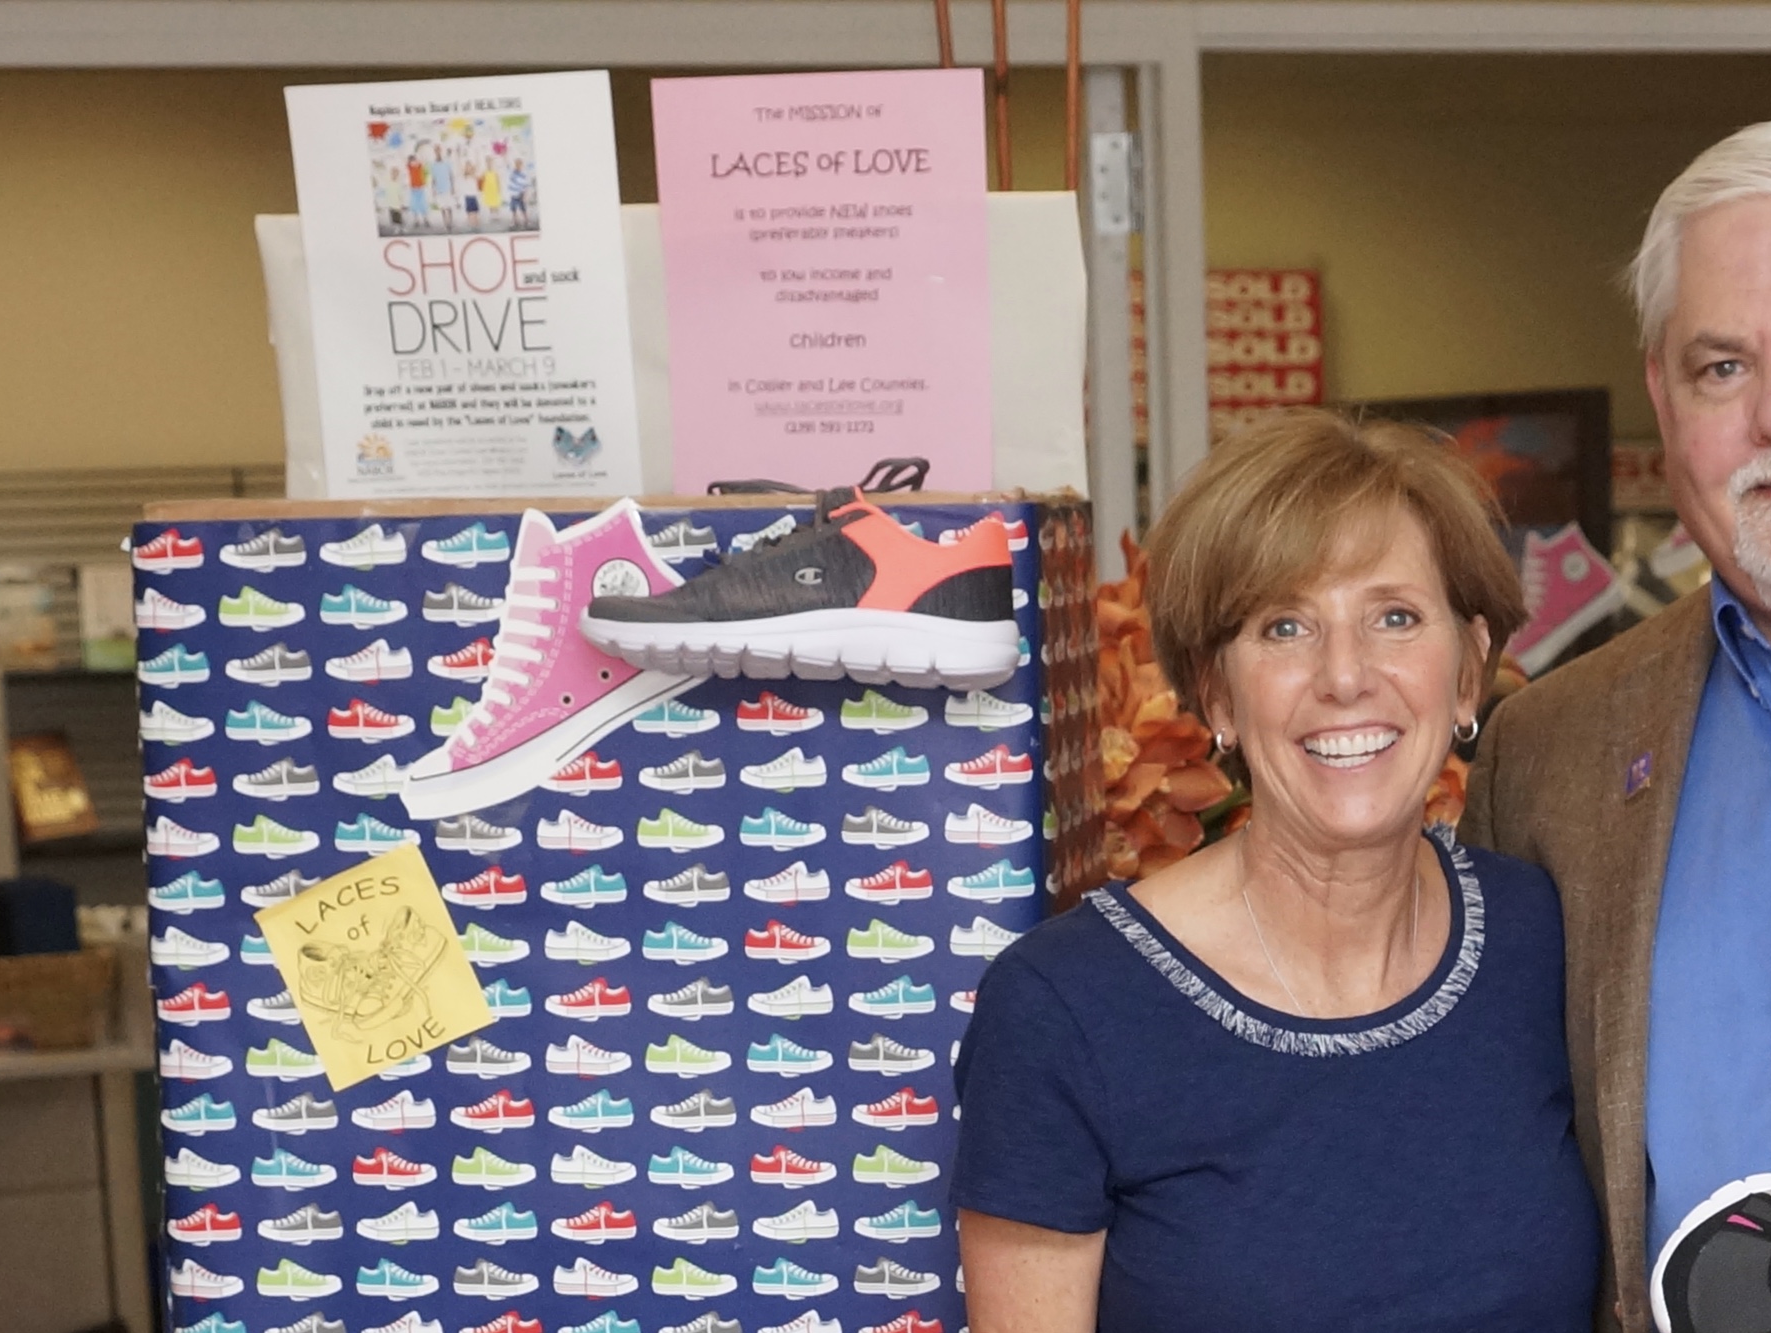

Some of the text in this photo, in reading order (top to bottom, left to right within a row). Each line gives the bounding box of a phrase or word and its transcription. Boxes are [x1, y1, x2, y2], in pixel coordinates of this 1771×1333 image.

[754, 103, 884, 123] The MISSION of
[710, 148, 931, 179] LACES of LOVE
[770, 204, 826, 222] provide
[830, 203, 868, 219] NEW
[872, 204, 914, 218] shoes
[383, 234, 544, 296] SHOE
[523, 267, 580, 285] and sock
[809, 267, 861, 281] income
[865, 267, 893, 281] and
[387, 296, 552, 355] DRIVE
[789, 332, 867, 349] Children
[397, 357, 436, 380] FEB
[440, 358, 447, 378] 1
[467, 356, 537, 378] MARCH
[543, 355, 556, 376] 9
[797, 378, 824, 392] and
[828, 377, 855, 392] Lee
[295, 876, 400, 936] LACES
[346, 913, 371, 941] of
[366, 1016, 446, 1064] LOVE
